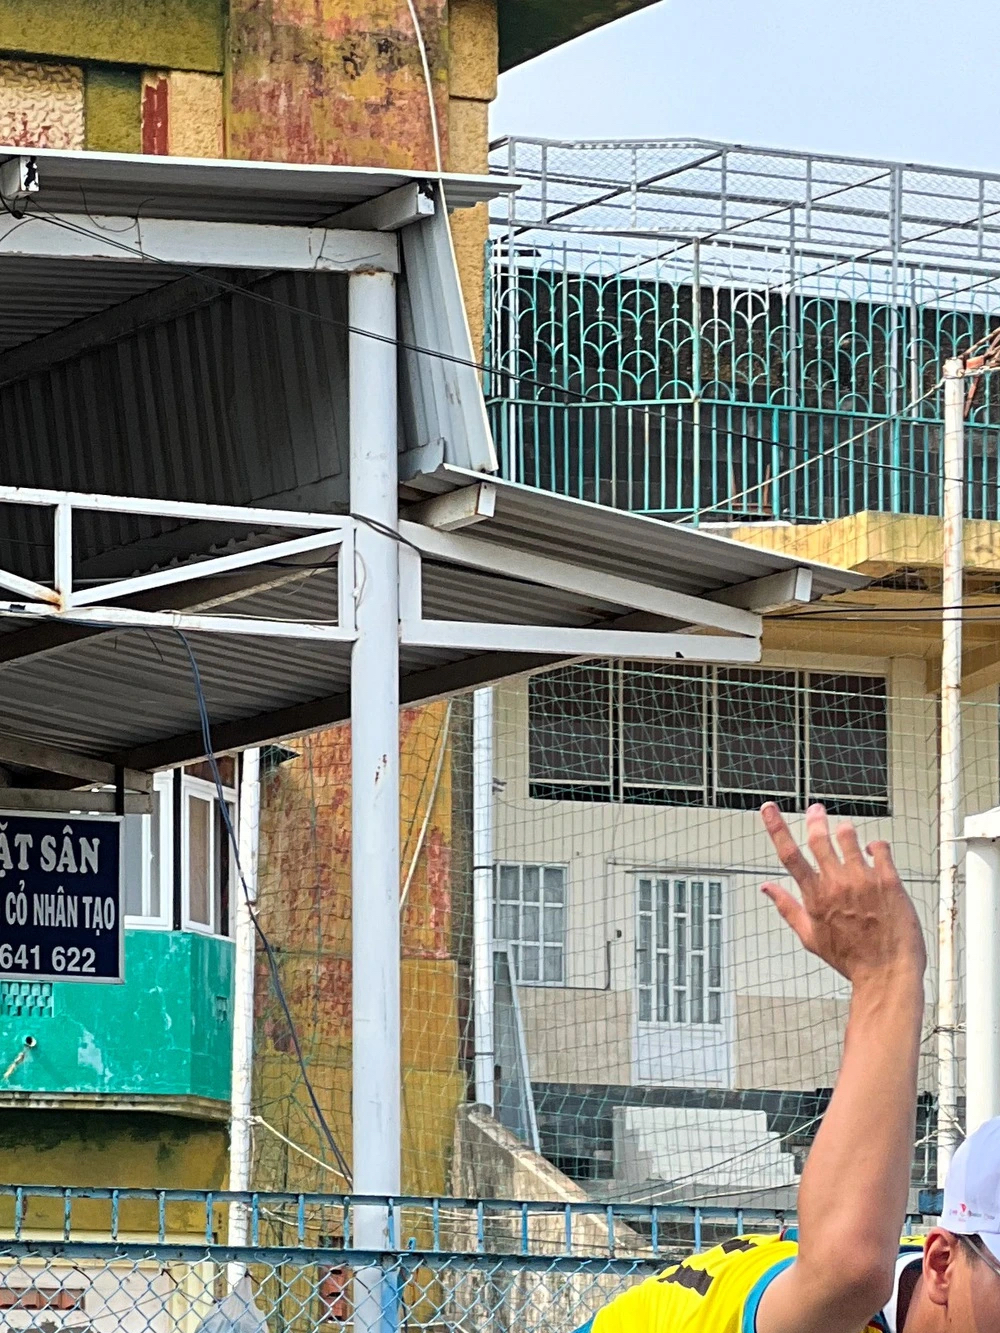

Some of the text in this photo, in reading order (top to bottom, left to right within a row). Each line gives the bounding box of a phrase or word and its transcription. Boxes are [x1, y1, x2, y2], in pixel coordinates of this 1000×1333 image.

[40, 824, 100, 875] SÂN
[5, 879, 115, 937] CỎ NHÂN TẠO
[0, 943, 96, 973] 641 622
